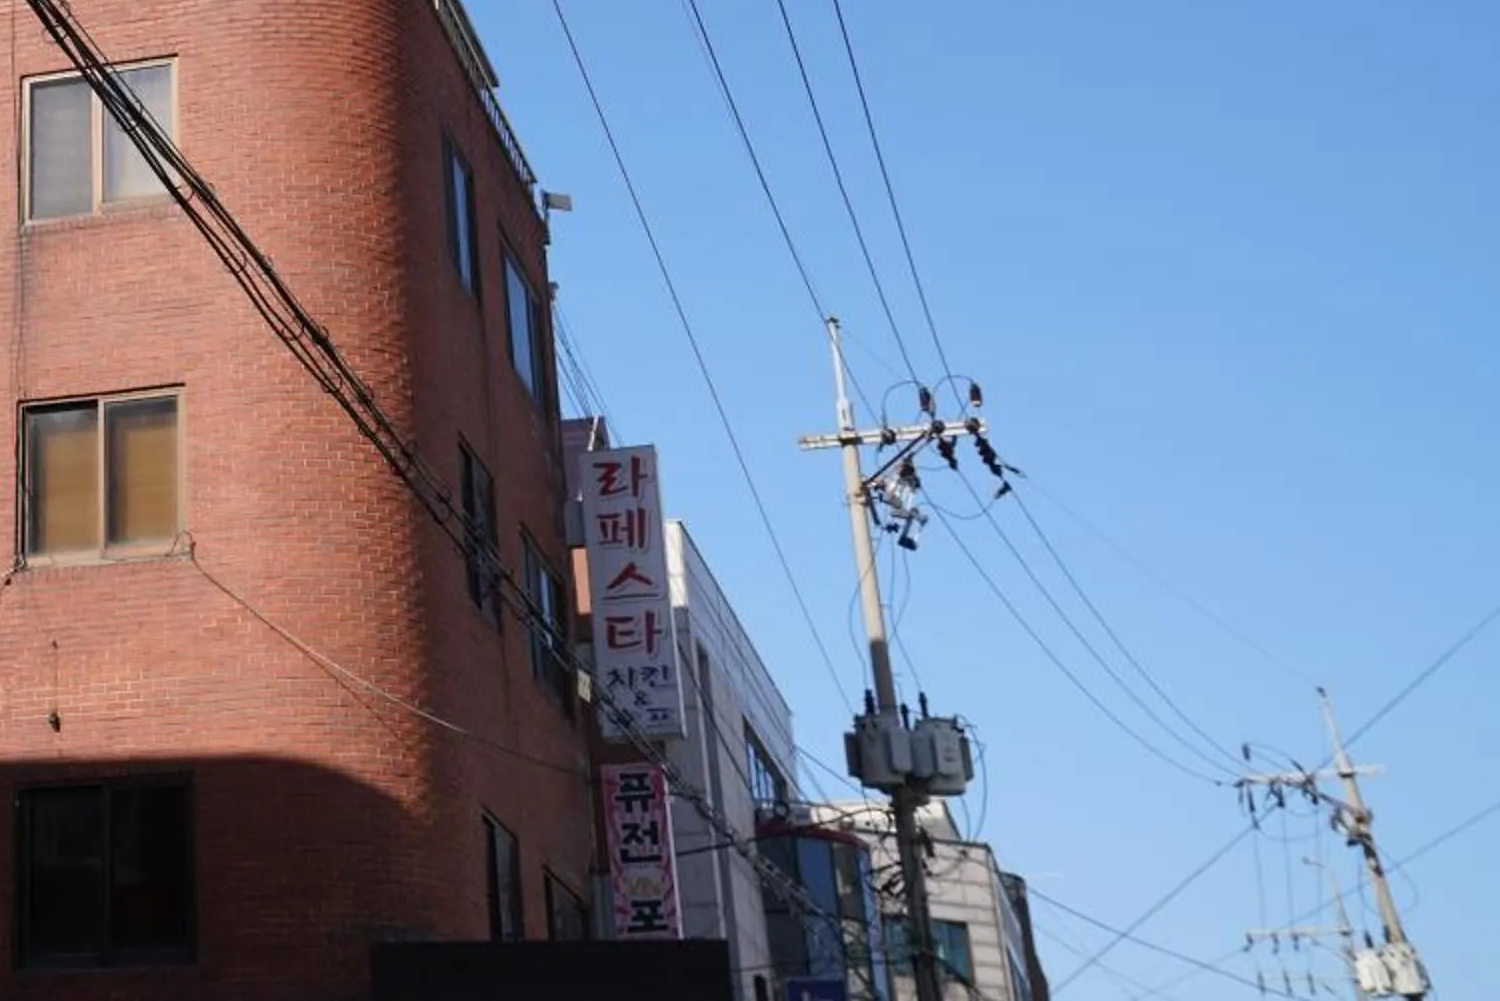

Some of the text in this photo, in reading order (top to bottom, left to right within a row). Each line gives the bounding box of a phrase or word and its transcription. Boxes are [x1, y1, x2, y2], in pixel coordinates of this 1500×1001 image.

[592, 455, 664, 655] 라페스타
[606, 663, 675, 691] 치킨
[614, 771, 663, 865] 퓨전
